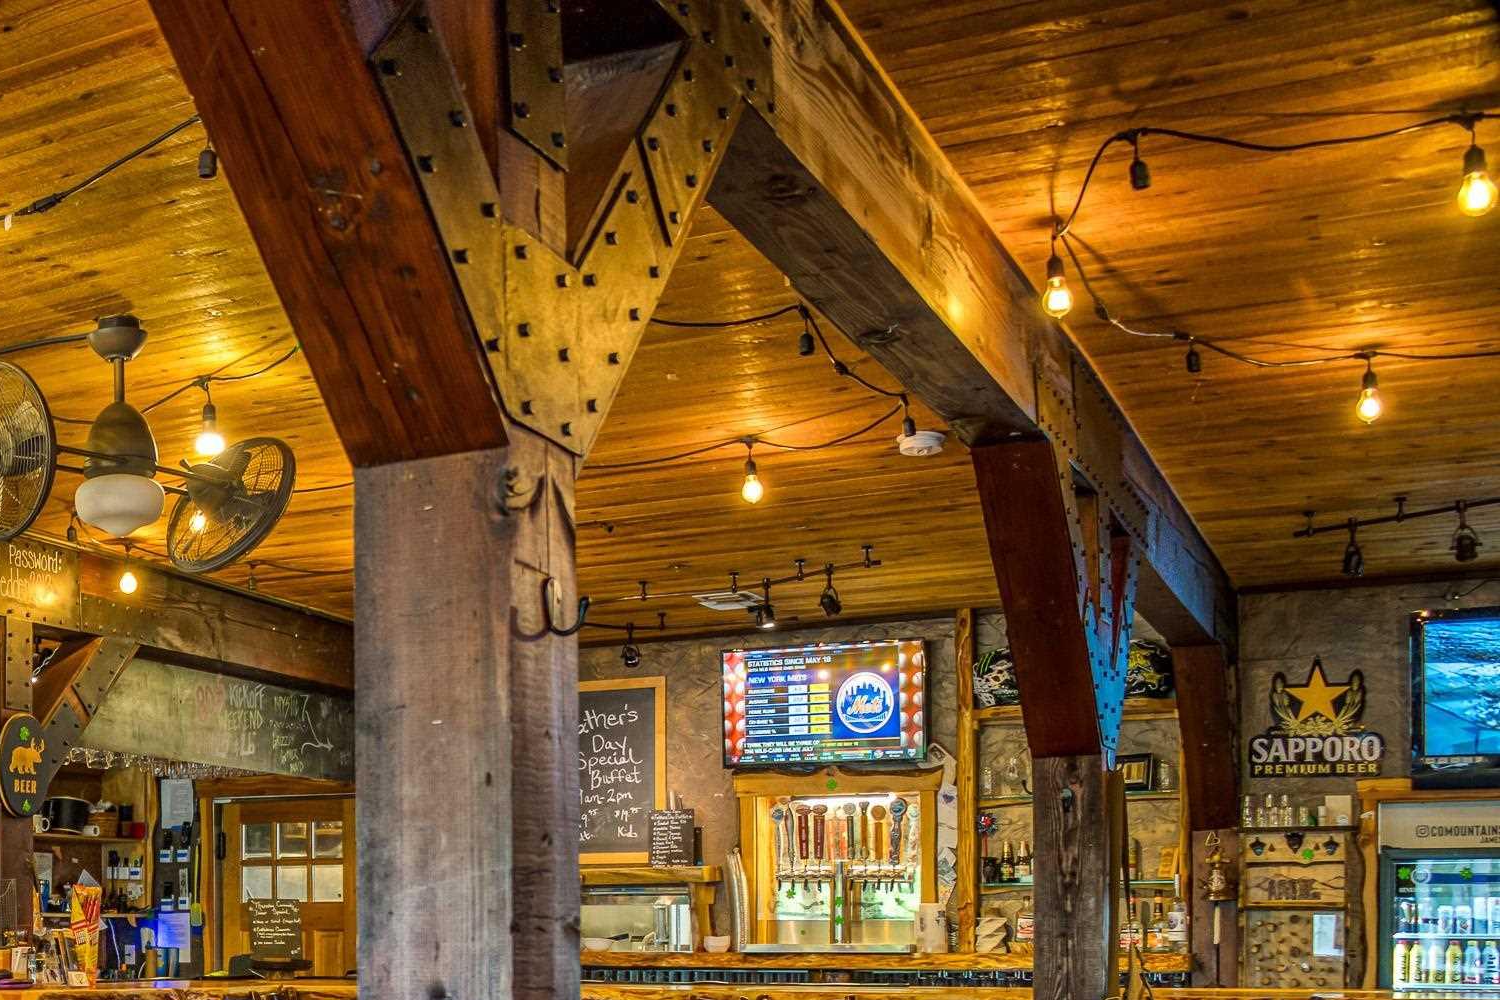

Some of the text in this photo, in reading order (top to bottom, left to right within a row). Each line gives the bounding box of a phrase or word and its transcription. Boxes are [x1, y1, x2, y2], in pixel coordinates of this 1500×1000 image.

[748, 676, 766, 684] NEW
[767, 675, 786, 683] YORK
[578, 703, 640, 735] ather's
[592, 734, 628, 756] Day
[1251, 736, 1381, 763] SAPPORO
[578, 747, 643, 775] Special
[1254, 763, 1378, 775] PREMIUM BEER
[13, 779, 37, 794] BEER
[590, 766, 643, 791] Buffet
